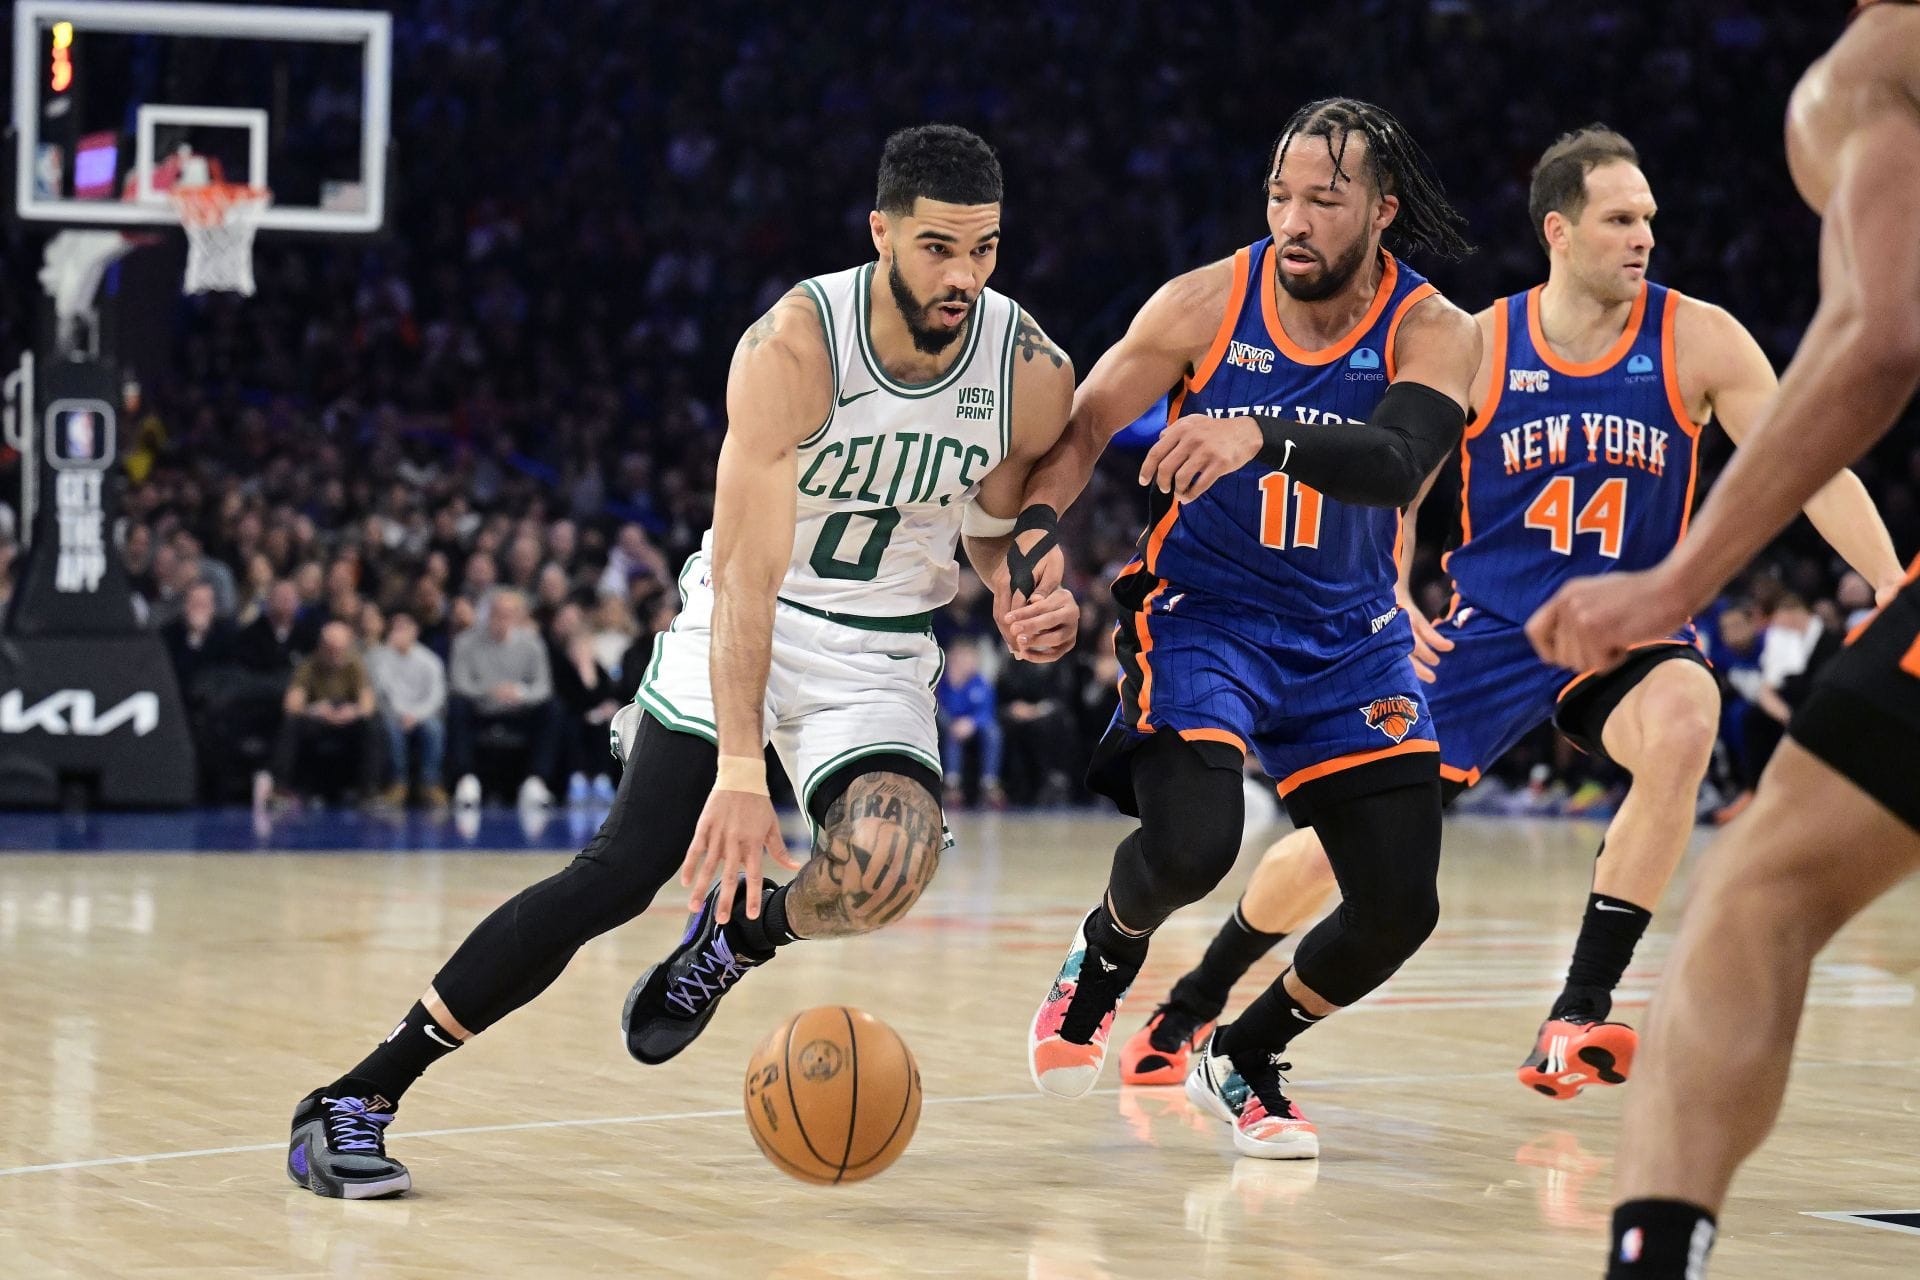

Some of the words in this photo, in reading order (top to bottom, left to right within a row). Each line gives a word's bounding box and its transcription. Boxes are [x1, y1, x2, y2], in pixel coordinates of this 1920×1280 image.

[1227, 340, 1275, 374] NYC
[1344, 371, 1384, 382] sphere
[1509, 369, 1550, 392] NYC
[1624, 374, 1658, 385] sphere
[958, 387, 995, 407] VISTA
[956, 405, 994, 420] PRINT
[1500, 414, 1571, 475] NEW
[1581, 412, 1669, 477] YORK
[797, 432, 990, 507] CELTICS
[1258, 471, 1323, 551] 11
[1524, 475, 1628, 559] 44
[809, 506, 902, 582] 0
[1367, 699, 1418, 725] KNICKS
